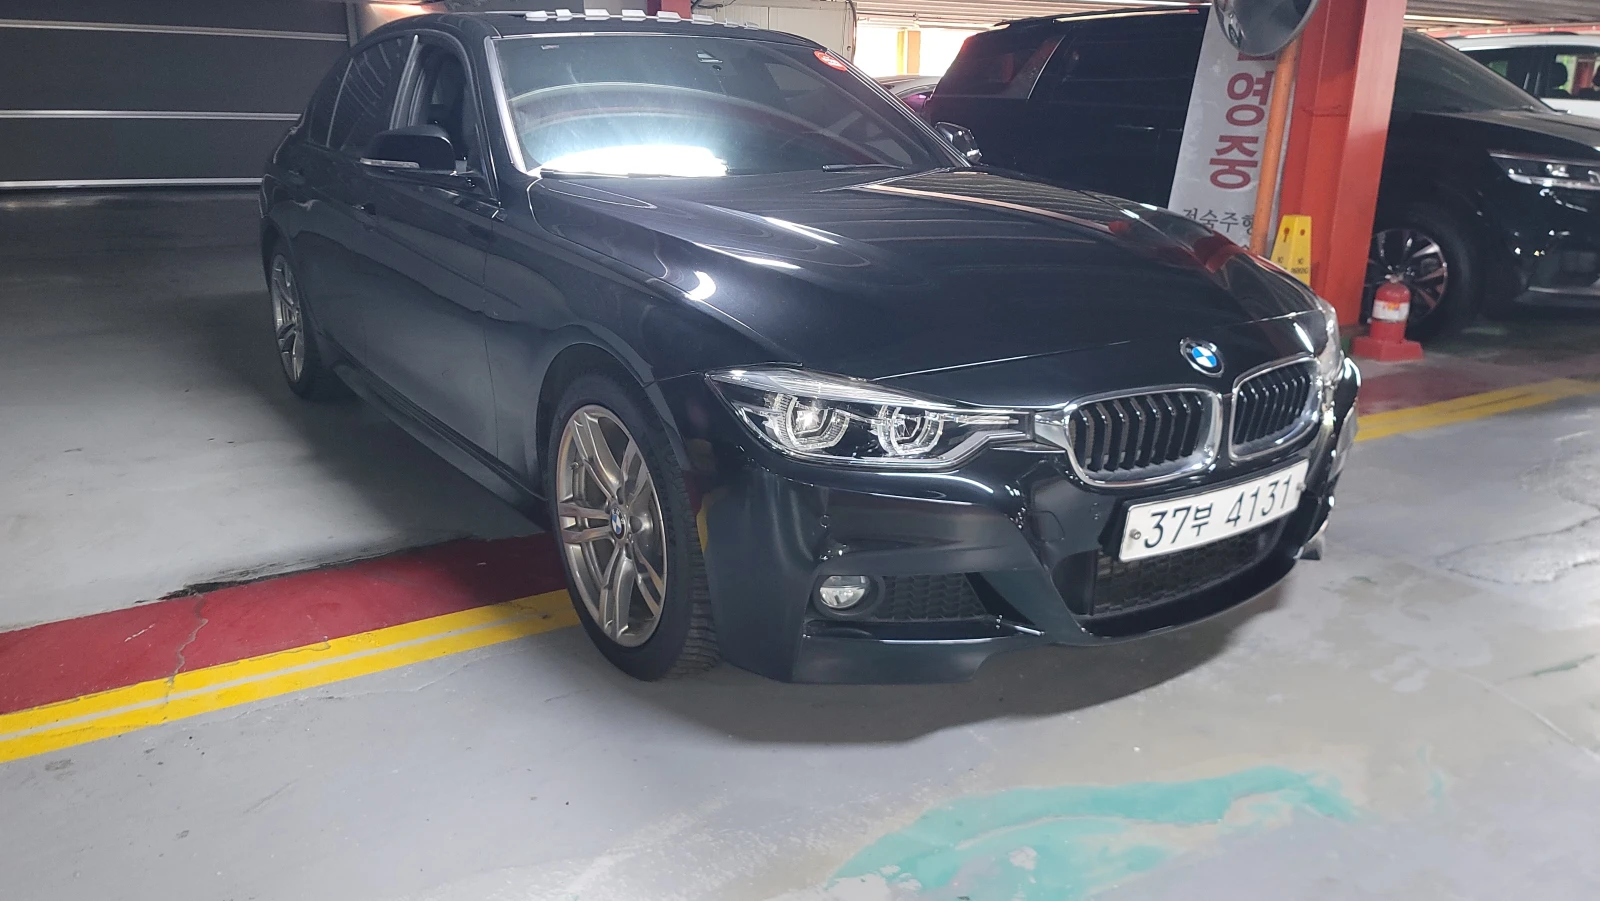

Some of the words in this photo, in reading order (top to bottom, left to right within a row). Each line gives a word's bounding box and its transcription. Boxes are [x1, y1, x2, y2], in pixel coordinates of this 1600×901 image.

[1209, 51, 1275, 190] 영중
[1144, 502, 1213, 549] 37부
[1225, 474, 1292, 527] 4131
